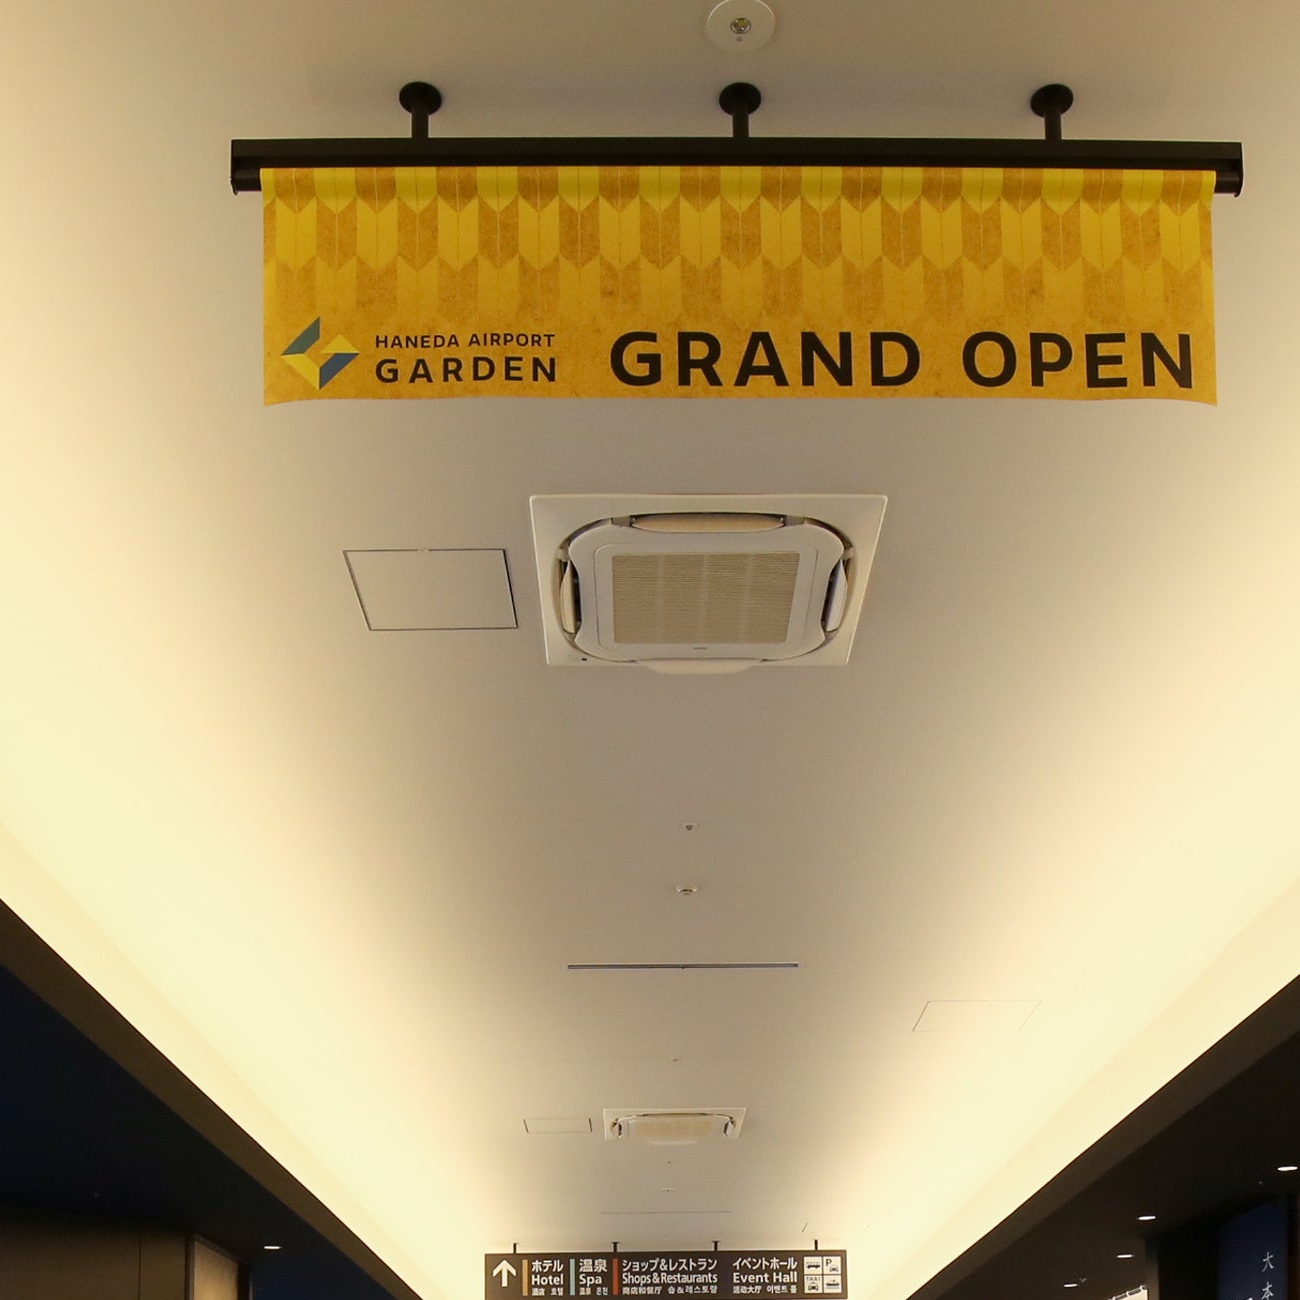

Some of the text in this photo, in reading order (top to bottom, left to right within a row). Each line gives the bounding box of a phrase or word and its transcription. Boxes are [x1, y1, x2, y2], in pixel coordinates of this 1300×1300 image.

[375, 332, 557, 350] HANEDA AIRPORT
[610, 330, 1193, 390] GRAND OPEN
[376, 354, 557, 384] GARDEN
[531, 1259, 564, 1273] ホテル
[579, 1258, 608, 1273] 温泉
[622, 1257, 718, 1272] ショップ&レストラン
[732, 1256, 798, 1270] イベントホール
[825, 1258, 832, 1266] P
[531, 1273, 564, 1286] Hotel
[579, 1273, 603, 1287] Spa
[732, 1271, 798, 1283] Event Hall
